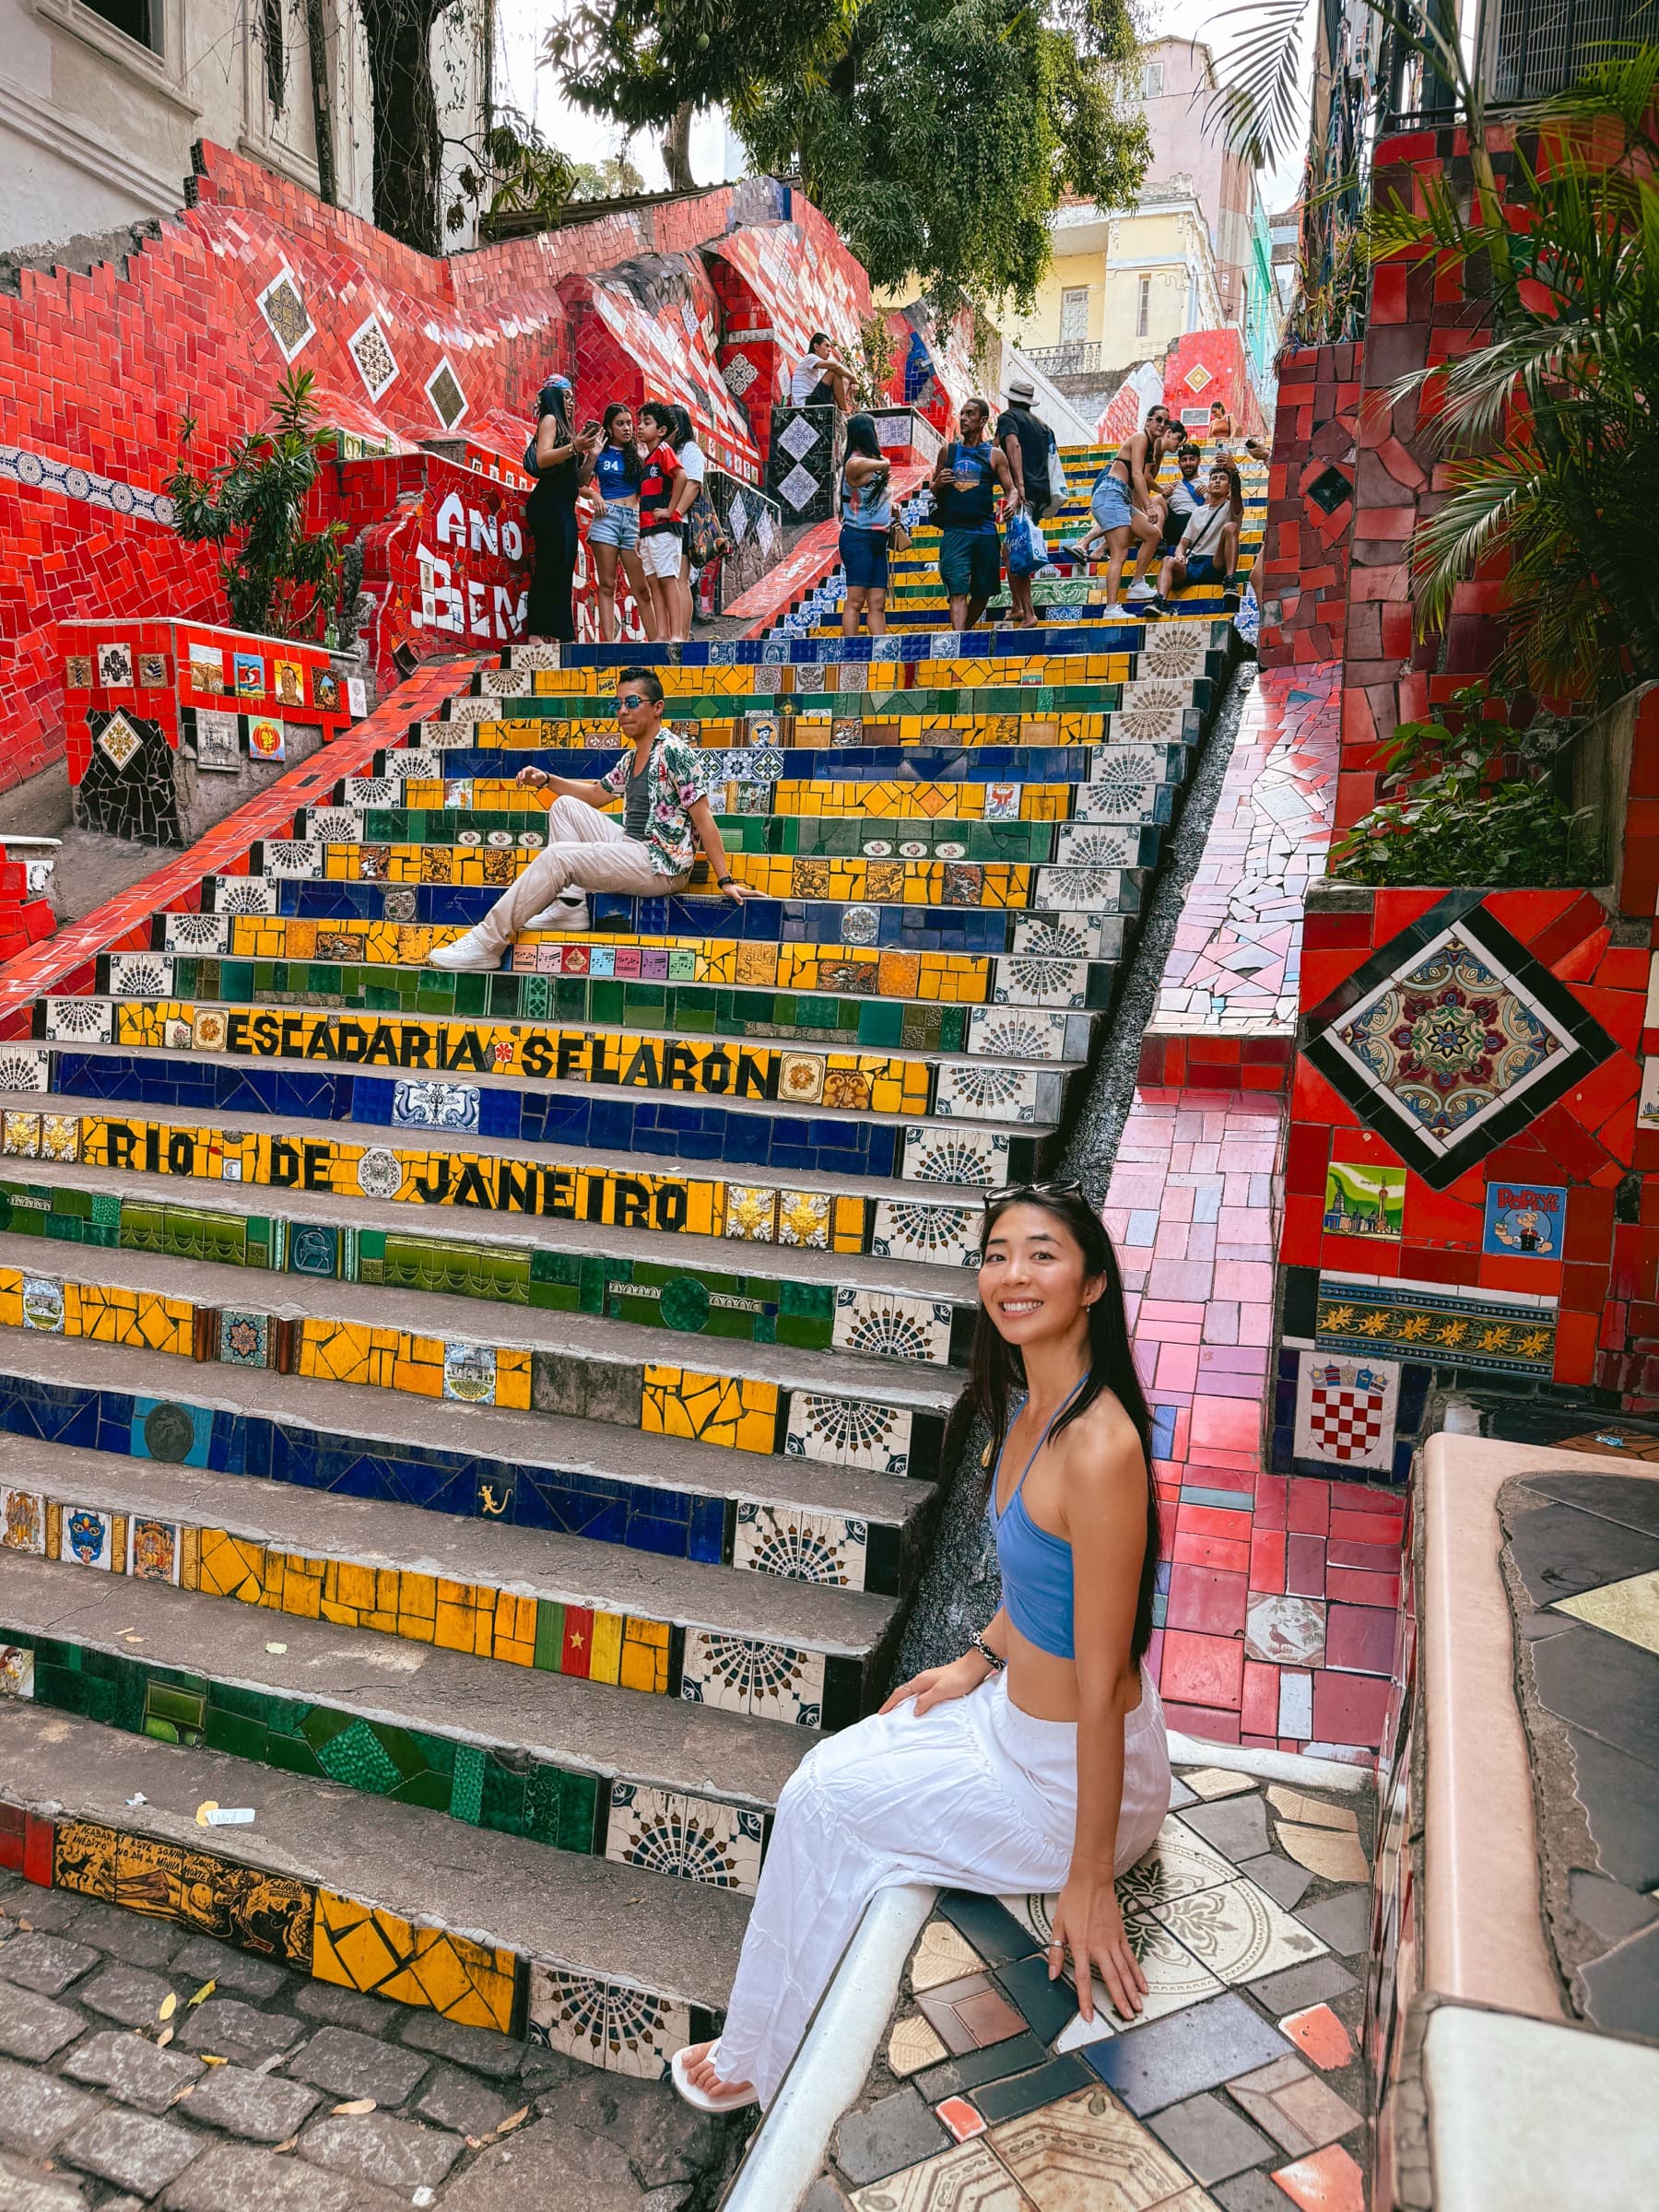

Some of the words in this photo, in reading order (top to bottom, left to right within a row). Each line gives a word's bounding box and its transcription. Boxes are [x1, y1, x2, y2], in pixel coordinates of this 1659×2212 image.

[437, 493, 523, 560] ANO
[227, 1014, 491, 1072] ESCADARIA
[522, 1036, 782, 1100] SELARON
[108, 1124, 194, 1176] RIO
[270, 1140, 333, 1191] DE
[416, 1159, 687, 1232] JANEIRO
[1497, 1188, 1559, 1212] POPEYE
[116, 1847, 129, 1856] NO
[182, 1865, 207, 1881] MORTE
[131, 1838, 152, 1852] ESTE
